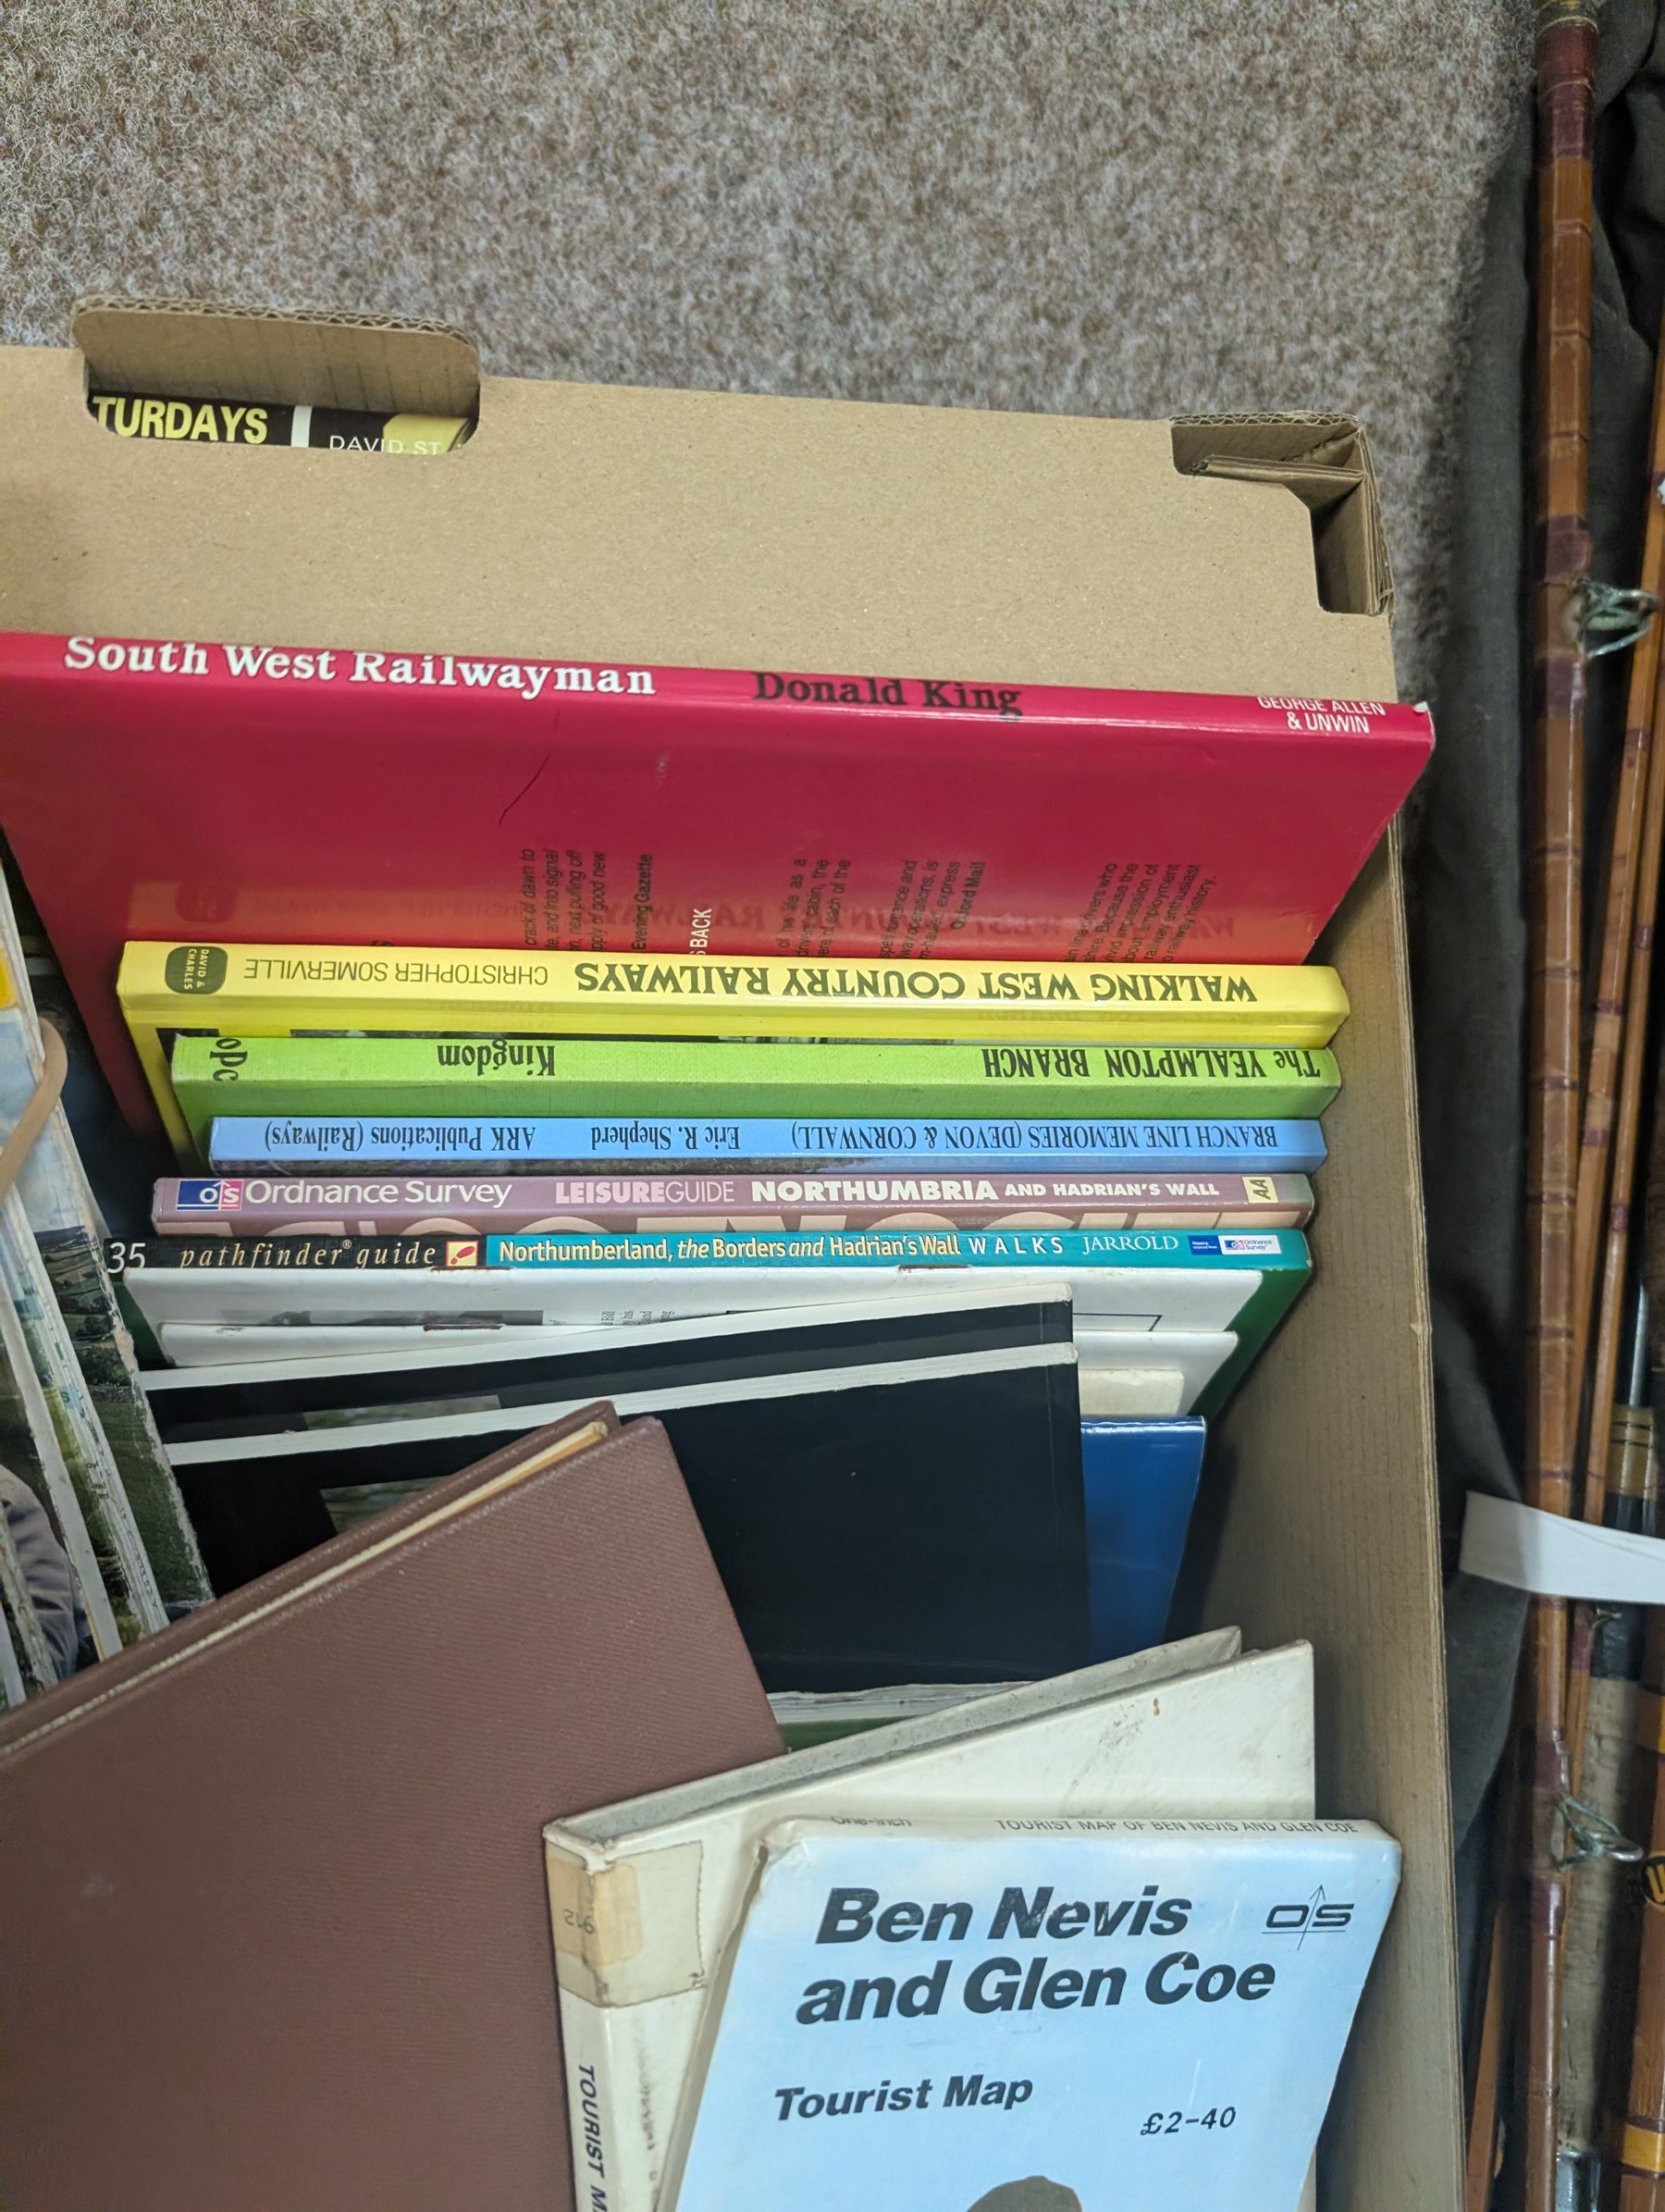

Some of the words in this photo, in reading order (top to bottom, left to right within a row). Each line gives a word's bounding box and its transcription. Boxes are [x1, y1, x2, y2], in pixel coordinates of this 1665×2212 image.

[65, 635, 208, 675] South
[223, 645, 335, 683] West
[350, 651, 655, 701] Railwayman
[752, 672, 907, 706] Donald
[919, 679, 1023, 721] King
[1257, 697, 1327, 712] GEORGE
[1332, 700, 1386, 716] ALLEN
[1287, 711, 1301, 730] &
[1304, 713, 1370, 734] UNWIN
[521, 849, 536, 860] to
[542, 850, 562, 886] signal
[567, 850, 581, 866] off
[593, 852, 605, 877] new
[811, 859, 829, 878] the
[922, 860, 939, 871] is
[521, 867, 536, 897] dawn
[634, 854, 651, 902] Gazette
[832, 859, 850, 879] the
[901, 859, 917, 883] and
[1097, 863, 1117, 887] who
[590, 882, 608, 910] good
[832, 883, 845, 895] of
[936, 861, 960, 908] express
[950, 890, 976, 930] Oxford
[964, 861, 985, 887] Mail
[1094, 884, 1128, 933] Because
[1117, 864, 1138, 882] the
[1138, 864, 1179, 932] employment
[521, 903, 535, 913] of
[824, 897, 841, 923] each
[1116, 879, 1152, 937] impression
[1144, 864, 1158, 875] of
[1143, 923, 1171, 959] railway
[1164, 864, 1200, 921] enthusiast
[544, 911, 559, 933] and
[567, 911, 581, 933] next
[588, 912, 605, 923] of
[632, 906, 652, 950] Evening
[689, 908, 711, 947] BACK
[1166, 917, 1196, 954] railway
[183, 948, 197, 990] CHARLES
[198, 948, 209, 977] DAVID
[244, 958, 388, 982] SOMERVILLE
[395, 962, 549, 985] CHRISTOPHER
[574, 963, 769, 995] RAILWAYS
[783, 968, 966, 999] COUNTRY
[979, 972, 1080, 1000] WEST
[1092, 973, 1257, 1002] WALKING
[210, 1038, 248, 1081] opc
[437, 1039, 555, 1076] Kingdom
[982, 1048, 1091, 1077] BRANCH
[1108, 1049, 1266, 1078] YEALMPTON
[1275, 1050, 1321, 1078] The
[265, 1119, 364, 1154] (Railways)
[371, 1125, 483, 1150] Publications
[491, 1126, 536, 1150] ARK
[591, 1120, 671, 1150] Shepherd
[678, 1125, 697, 1150] R.
[705, 1125, 740, 1150] Eric
[792, 1120, 917, 1150] CORNWALL)
[925, 1126, 938, 1146] &
[944, 1120, 1022, 1148] (DEVON
[1029, 1125, 1138, 1148] MEMORIES
[1143, 1125, 1191, 1147] LINE
[1195, 1125, 1278, 1147] BRANCH
[246, 1180, 398, 1204] Ordnance
[405, 1180, 512, 1208] Survey
[555, 1180, 734, 1204] LEISUREGUIDE
[751, 1180, 999, 1202] NORTHUMBRIA
[1005, 1183, 1046, 1196] AND
[1053, 1182, 1161, 1196] HADRIAN'S
[1166, 1182, 1220, 1195] WALL
[1253, 1179, 1269, 1200] AA
[106, 1242, 146, 1274] 35
[355, 1242, 436, 1269] guide
[500, 1239, 673, 1262] Northumberland,
[677, 1239, 709, 1259] the
[712, 1237, 785, 1259] Borders
[789, 1236, 823, 1257] and
[831, 1236, 918, 1256] Hadrian's
[919, 1234, 959, 1255] Wall
[968, 1236, 1064, 1254] WALKS
[1082, 1235, 1178, 1256] JARROLD
[995, 1820, 1073, 1831] TOURIST
[1079, 1820, 1116, 1831] MAP
[1123, 1821, 1146, 1831] OF
[1151, 1821, 1187, 1832] BEN
[1189, 1822, 1239, 1832] NEVIS
[1241, 1822, 1277, 1832] AND
[1279, 1822, 1322, 1833] GLEN
[1325, 1823, 1359, 1834] COE
[815, 1886, 973, 1944] Ben
[987, 1884, 1191, 1940] Nevis
[796, 1959, 953, 2025] and
[963, 1957, 1127, 2014] Glen
[1144, 1951, 1276, 2006] Coe
[774, 2078, 932, 2121] Tourist
[943, 2074, 1033, 2110] Map
[579, 2065, 605, 2179] TOURIST
[1140, 2106, 1236, 2136] £2-40
[590, 2184, 608, 2212] M
